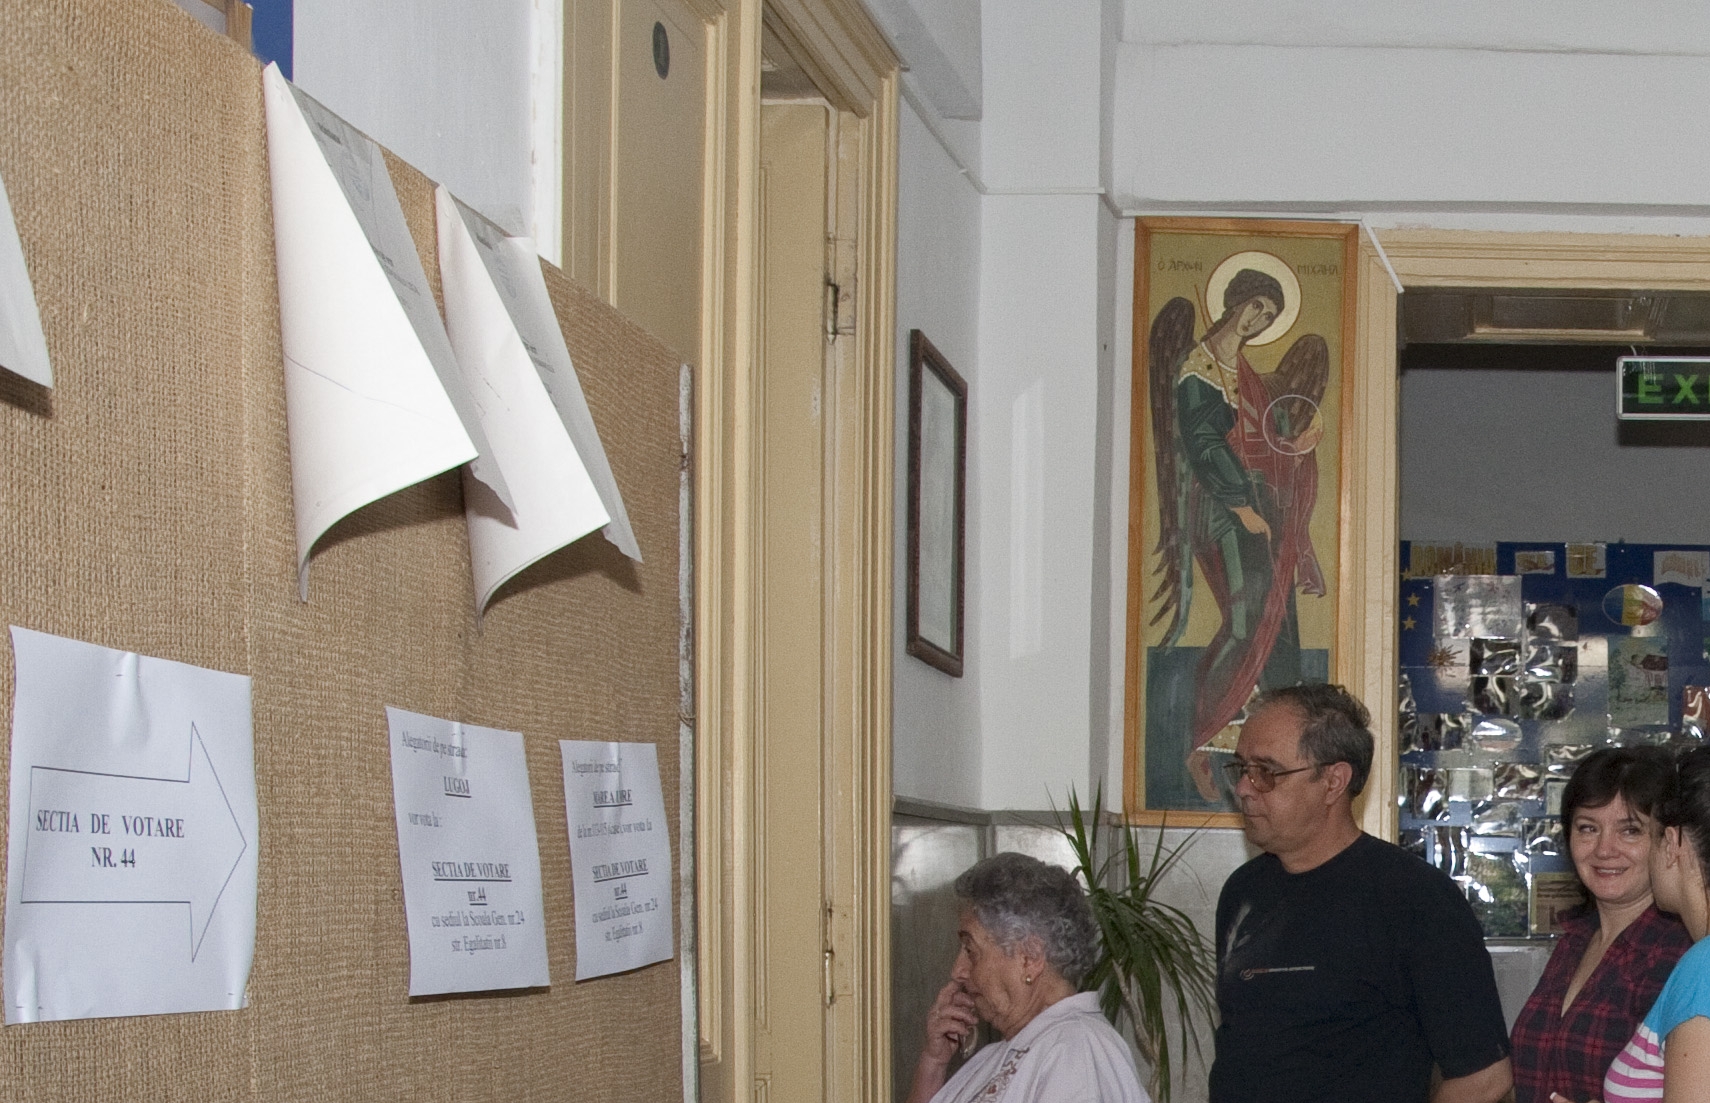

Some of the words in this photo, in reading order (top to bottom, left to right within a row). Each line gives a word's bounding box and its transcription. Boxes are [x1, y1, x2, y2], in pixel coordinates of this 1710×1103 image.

[443, 776, 471, 794] LUGOJ
[36, 809, 80, 833] SECTIA
[91, 813, 111, 834] DE
[122, 815, 185, 838] VOTARE
[91, 846, 117, 868] NR.
[120, 848, 136, 868] 44
[432, 861, 464, 878] SECTIA
[464, 862, 477, 878] DE
[476, 862, 511, 879] VOTARE
